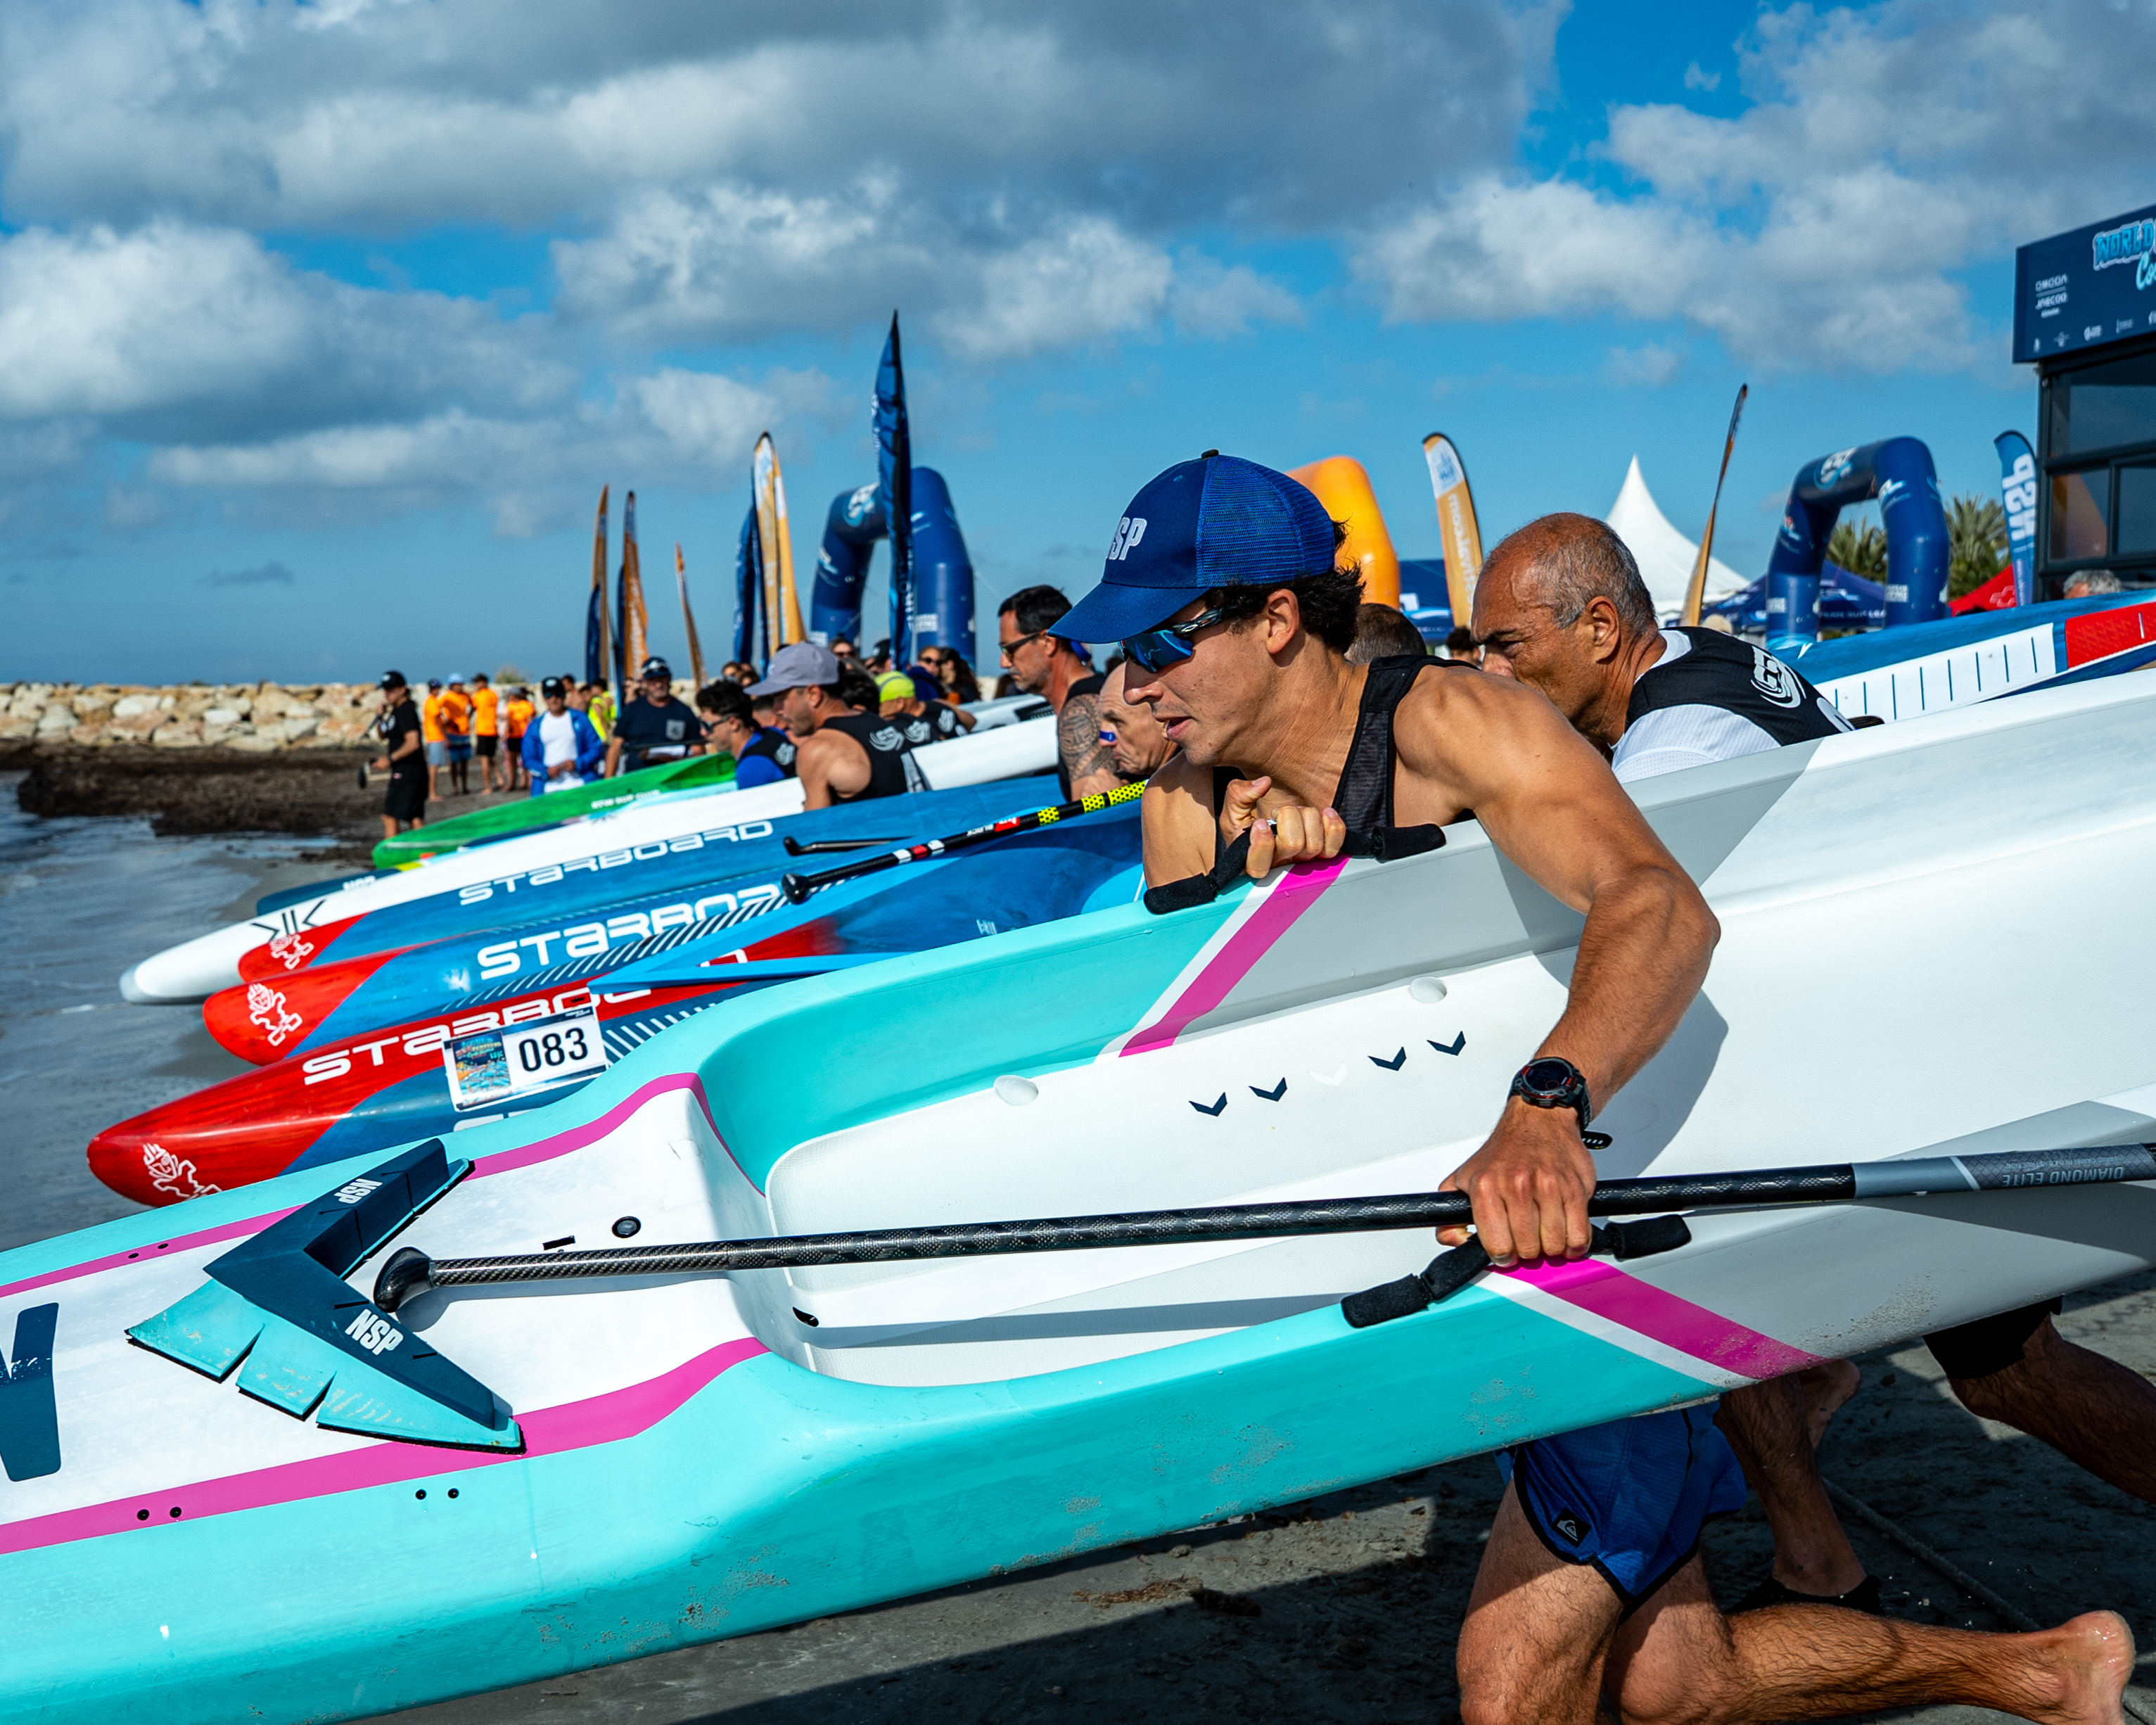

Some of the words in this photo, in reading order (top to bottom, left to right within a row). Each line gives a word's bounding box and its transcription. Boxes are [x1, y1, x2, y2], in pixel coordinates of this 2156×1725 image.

[2094, 220, 2155, 267] WORLD
[1105, 516, 1148, 561] SP
[459, 820, 773, 907] STARBOARD
[518, 1027, 589, 1072] 083
[334, 1178, 383, 1204] NSP
[2001, 1171, 2043, 1187] ELITE
[2049, 1166, 2124, 1184] DIAMOND
[345, 1308, 404, 1356] NSP
